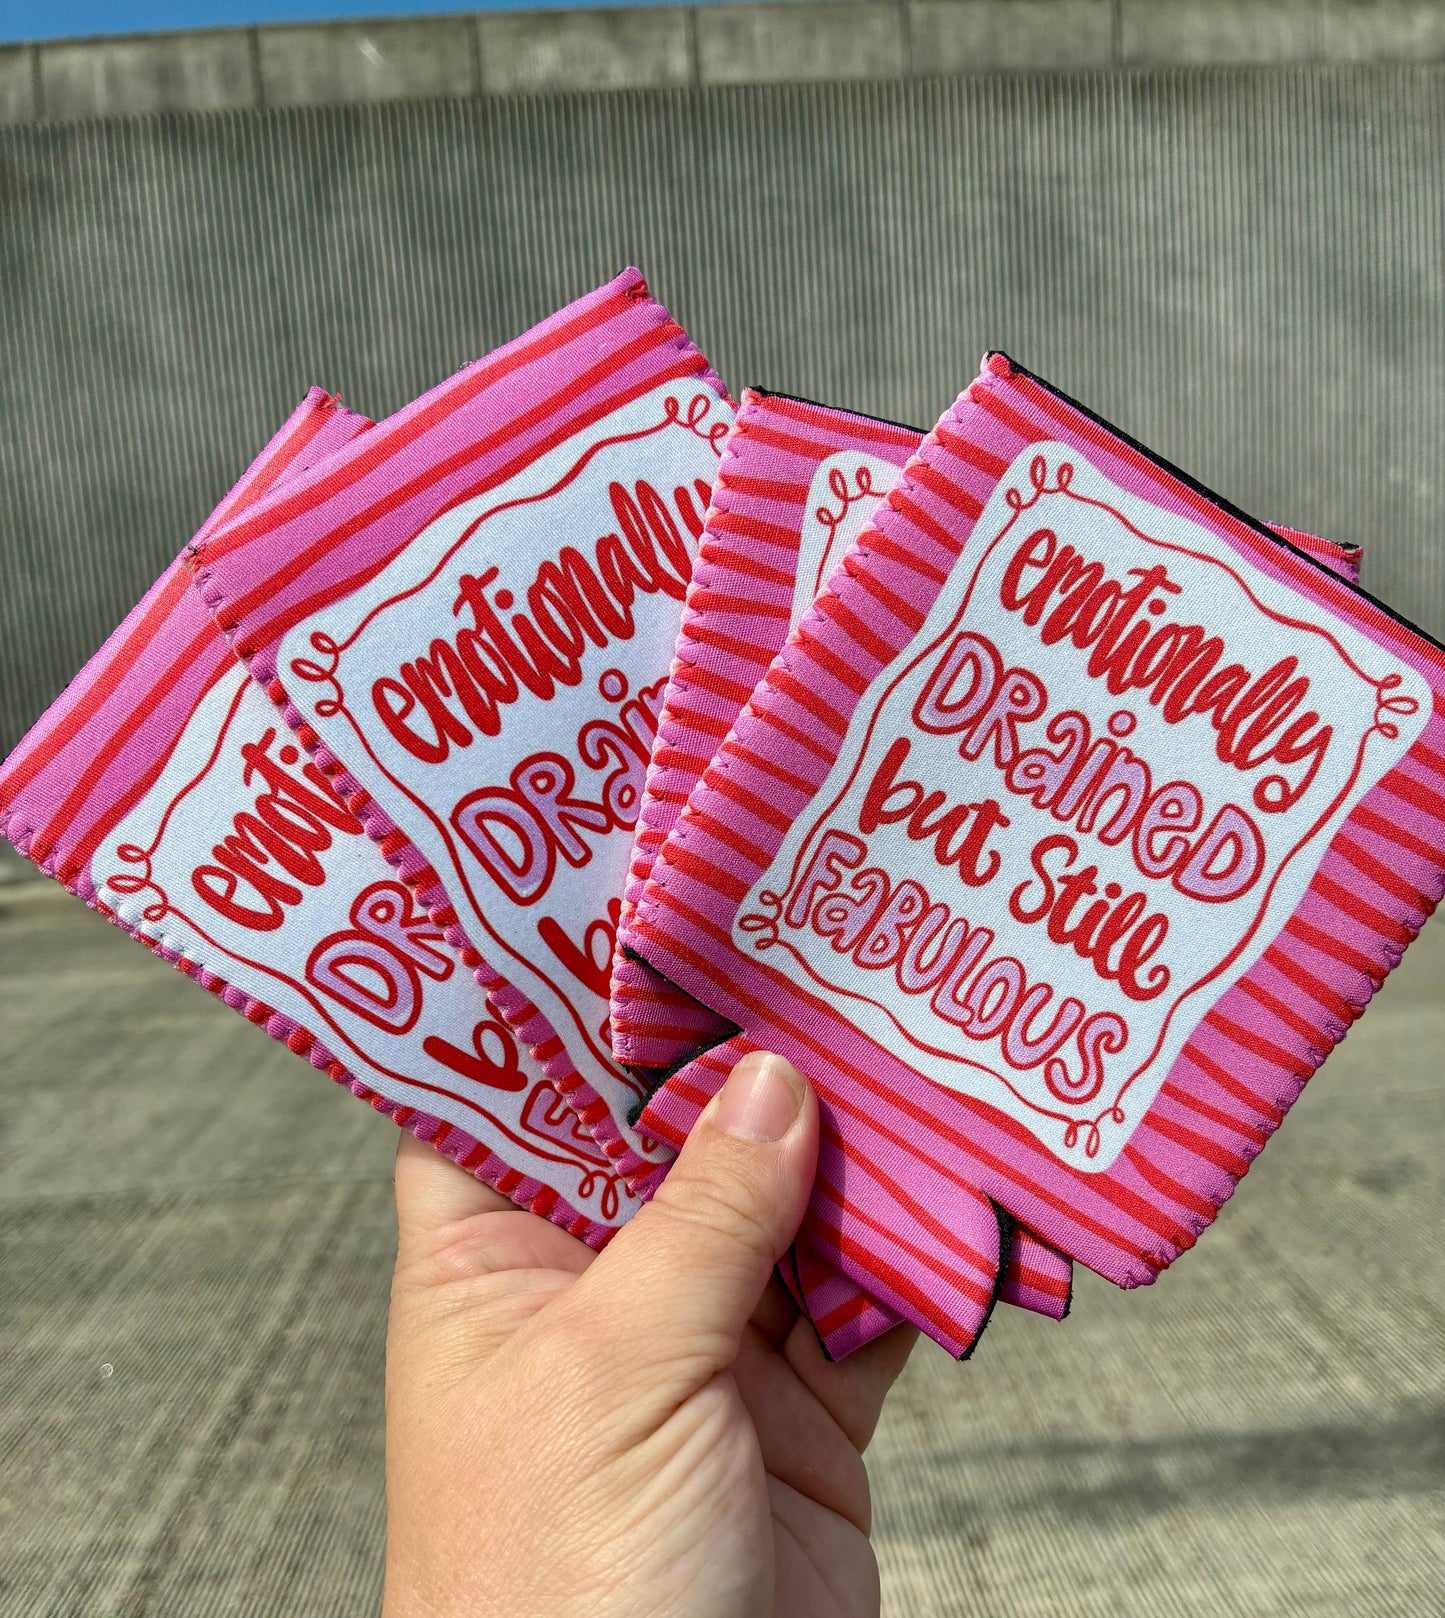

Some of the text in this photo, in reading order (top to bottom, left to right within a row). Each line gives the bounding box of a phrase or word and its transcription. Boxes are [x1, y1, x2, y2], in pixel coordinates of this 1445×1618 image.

[450, 668, 670, 906] DRai
[1000, 529, 1332, 813] emotionally
[305, 880, 455, 1036] DR
[858, 738, 1170, 1001] but Still
